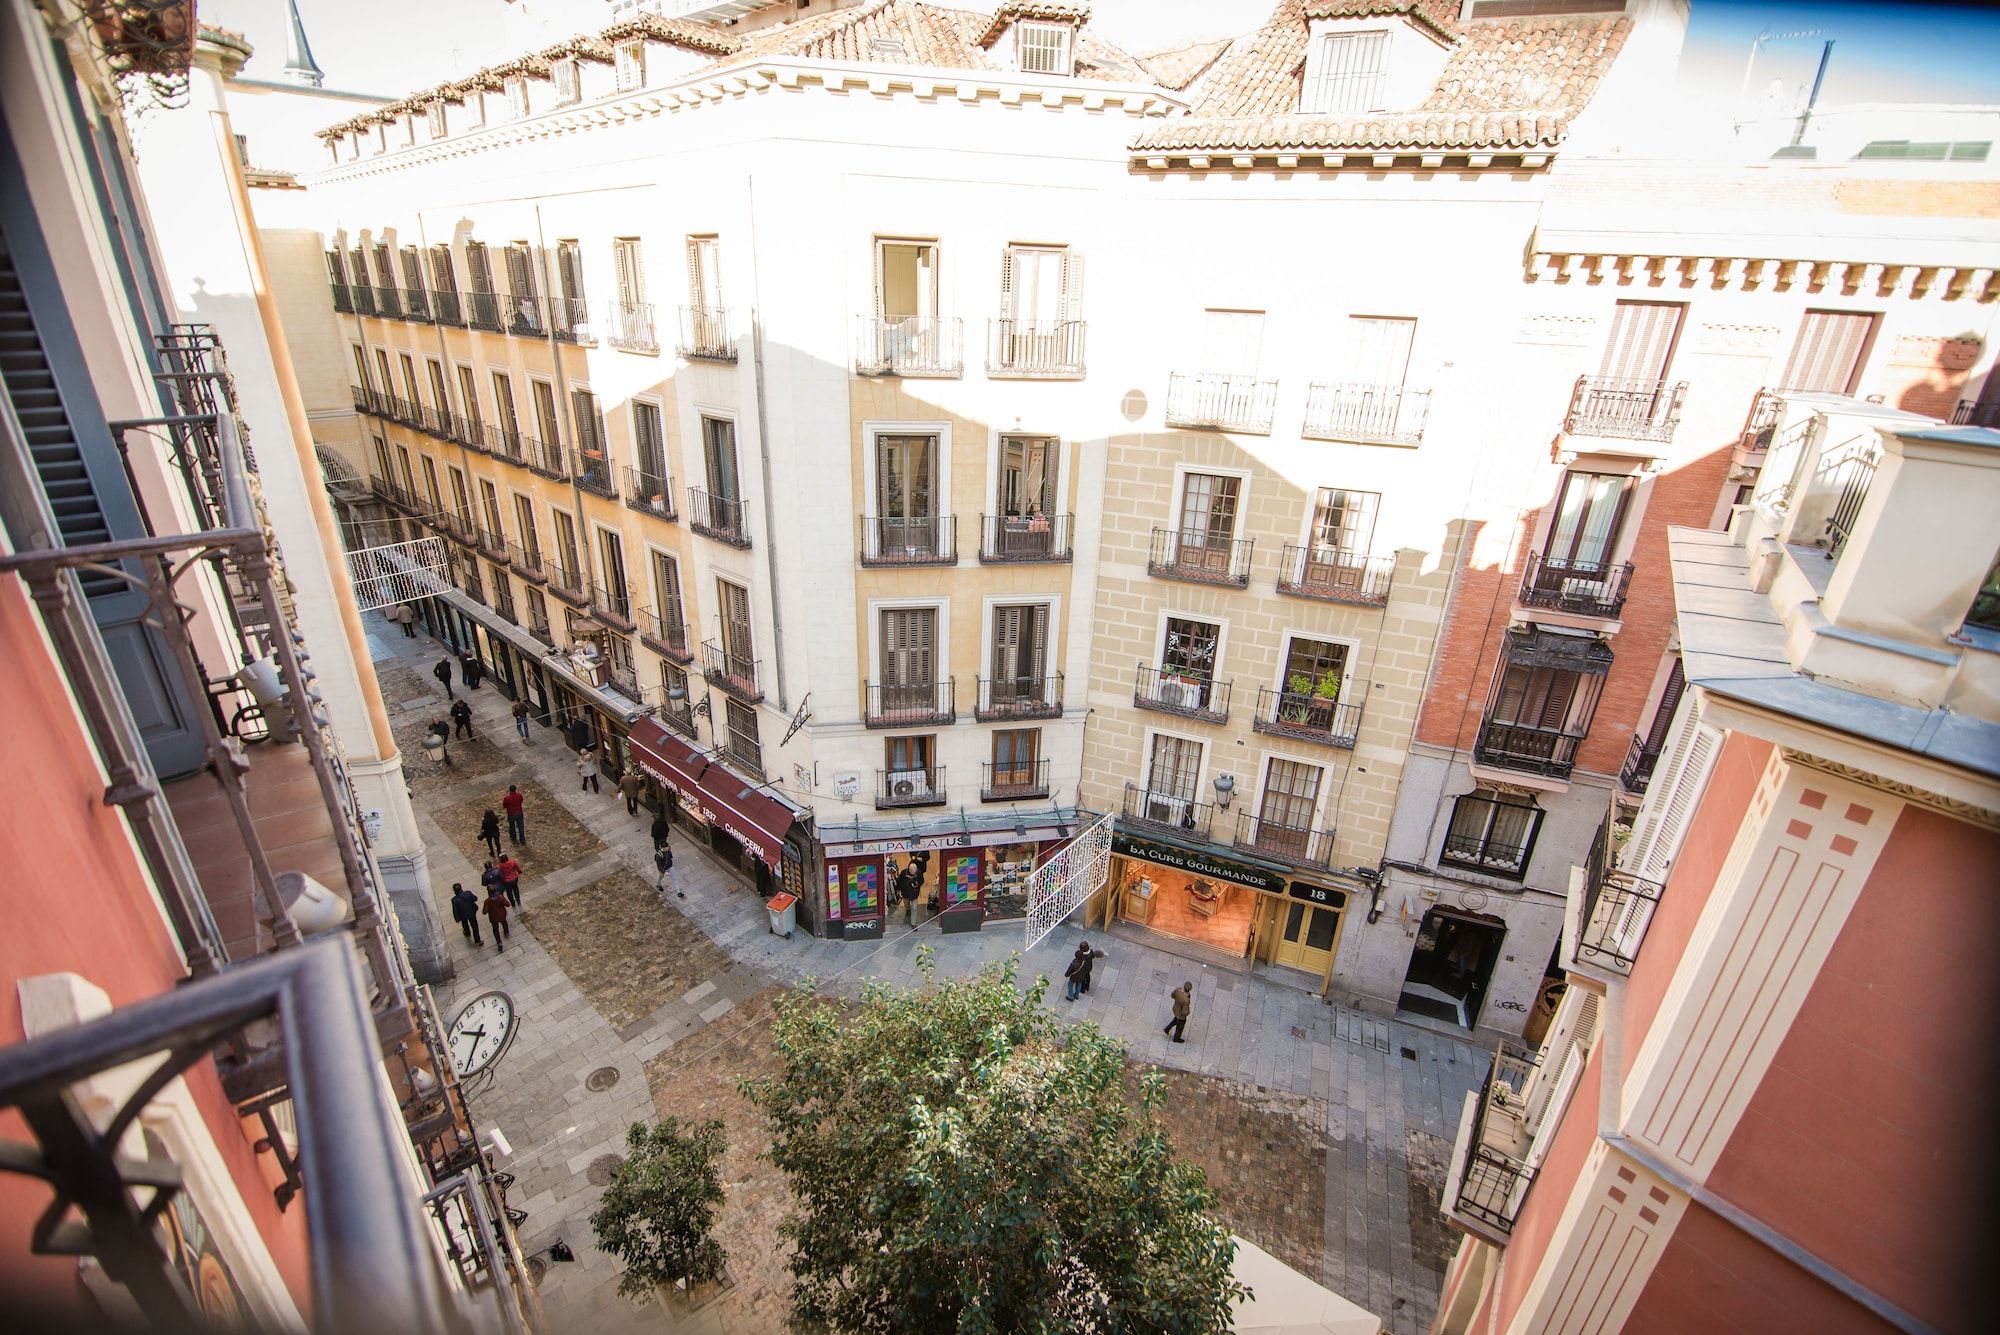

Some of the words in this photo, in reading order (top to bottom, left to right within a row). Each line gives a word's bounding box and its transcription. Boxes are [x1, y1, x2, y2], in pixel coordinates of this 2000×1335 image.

[829, 848, 843, 856] 20
[1310, 888, 1326, 901] 18
[491, 999, 499, 1009] 2
[465, 1006, 476, 1019] 12
[498, 1007, 505, 1016] 3
[455, 1021, 465, 1032] 11
[492, 1036, 499, 1045] 5
[481, 1050, 488, 1059] 6
[456, 1060, 464, 1069] 8
